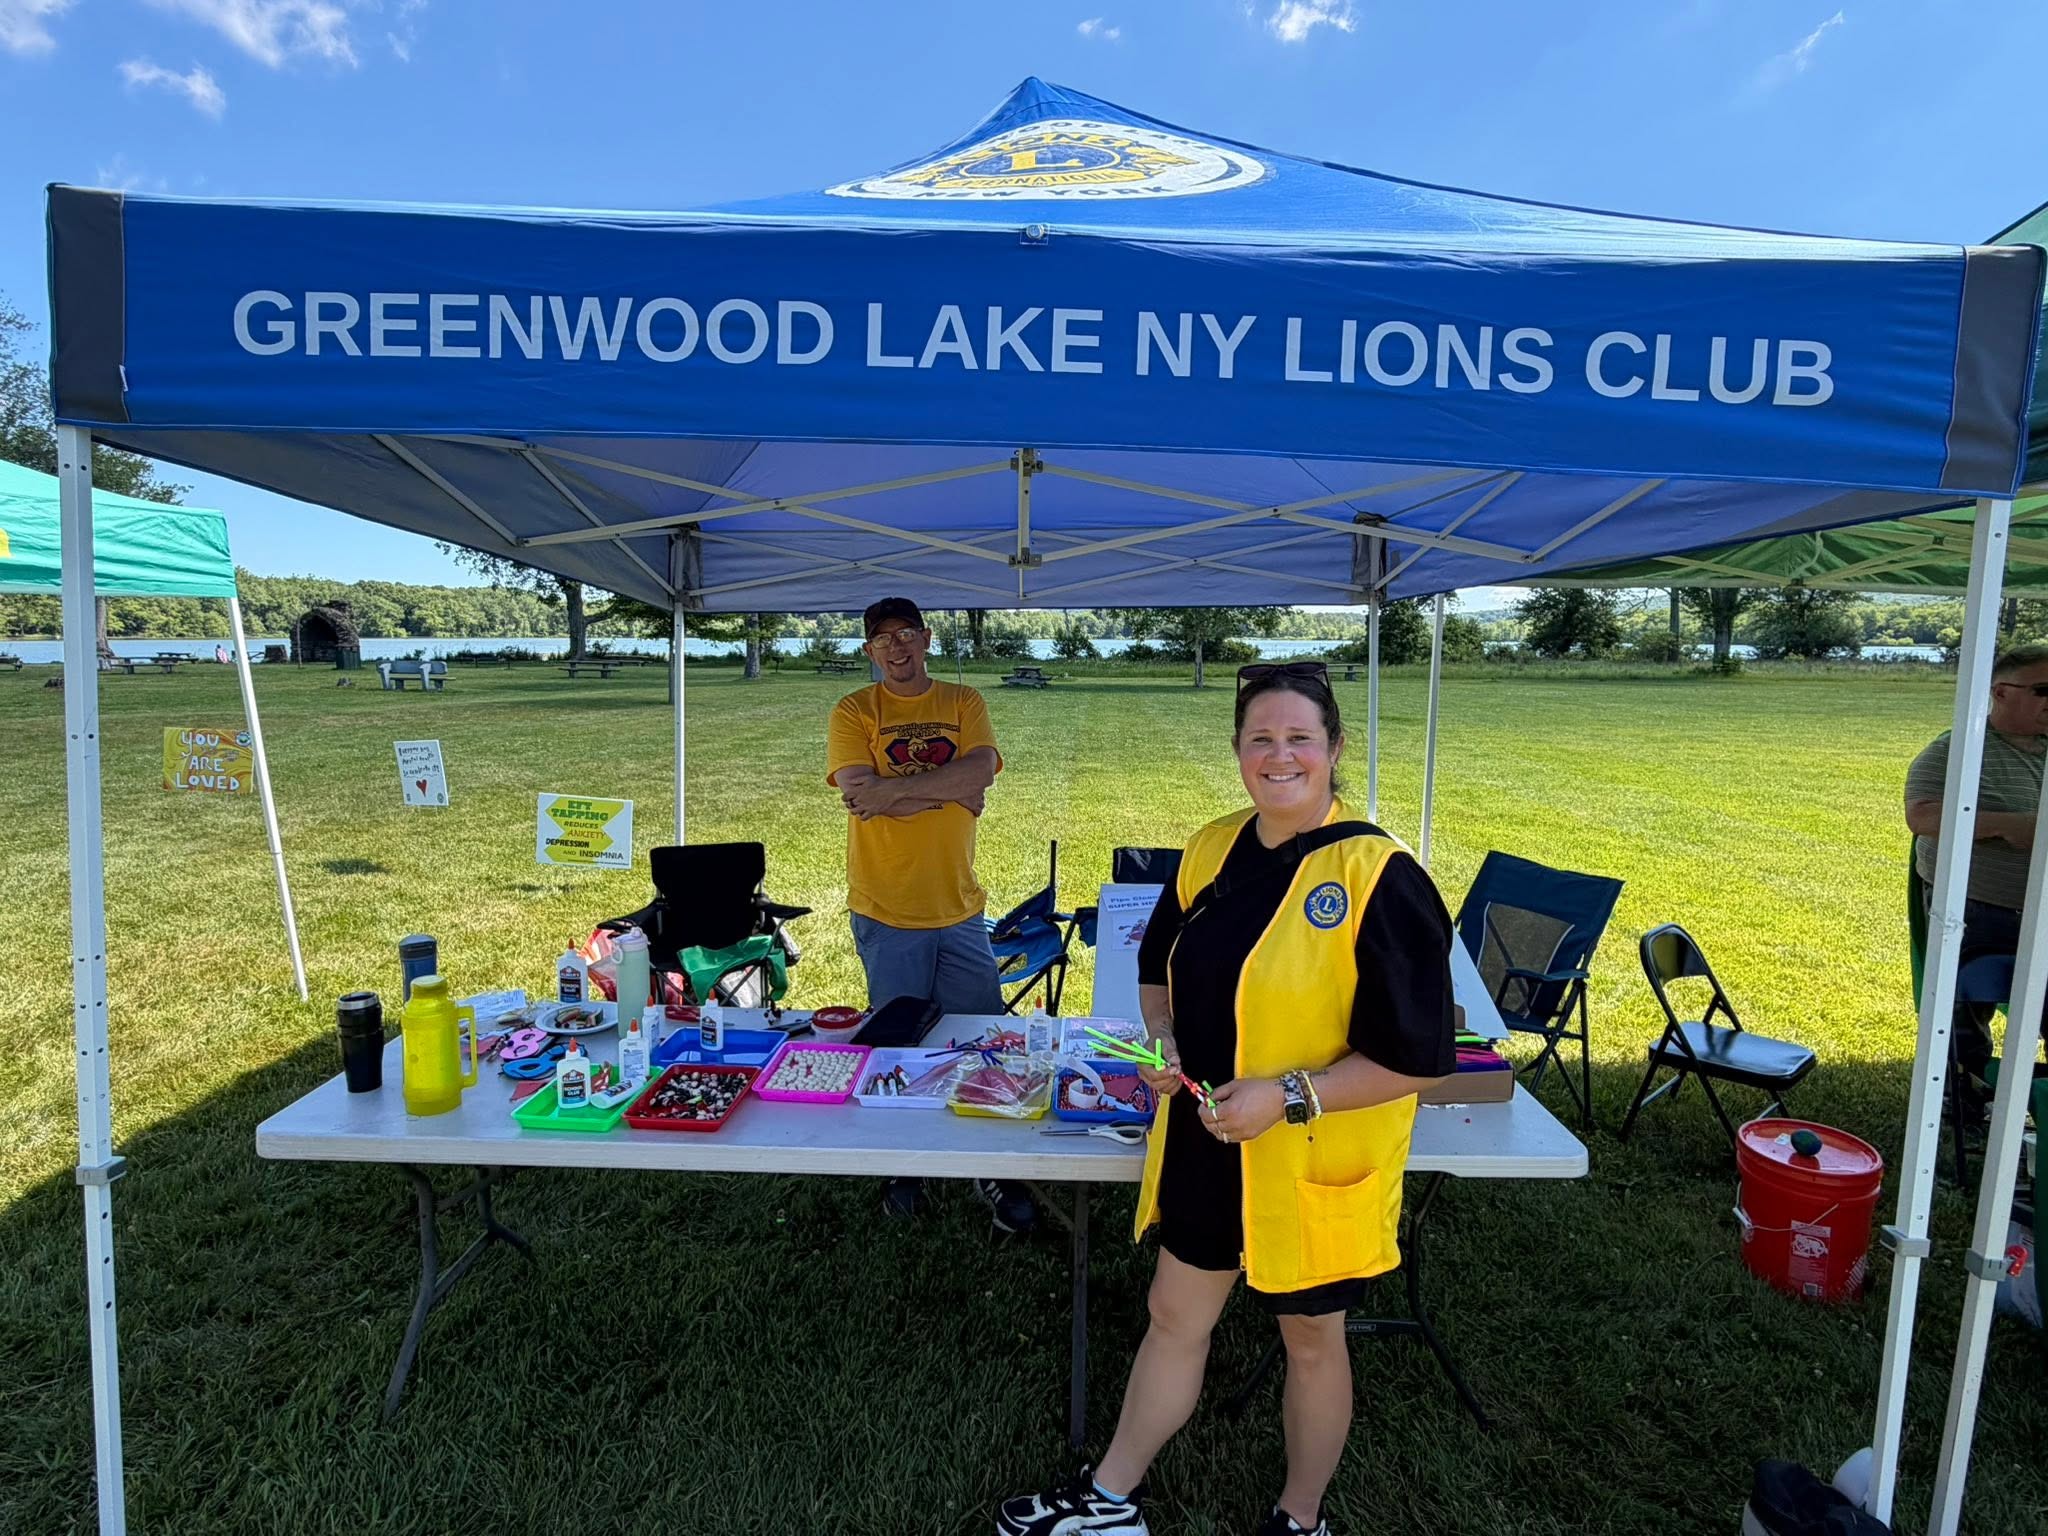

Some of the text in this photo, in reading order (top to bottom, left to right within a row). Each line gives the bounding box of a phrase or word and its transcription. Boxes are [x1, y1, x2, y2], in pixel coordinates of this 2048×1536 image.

[1044, 185, 1176, 197] YORK
[234, 289, 1834, 406] GREENWOOD LAKE NY LIONS CLUB
[189, 756, 225, 772] ARE
[176, 772, 240, 791] LOVED
[567, 800, 592, 810] EFT
[551, 808, 608, 821] TAPPING
[564, 820, 598, 829] REDUCES
[567, 829, 607, 839] ANXIETY
[545, 838, 590, 848] DEPRESSION
[579, 849, 624, 860] INSOMNIA
[1322, 897, 1333, 912] L
